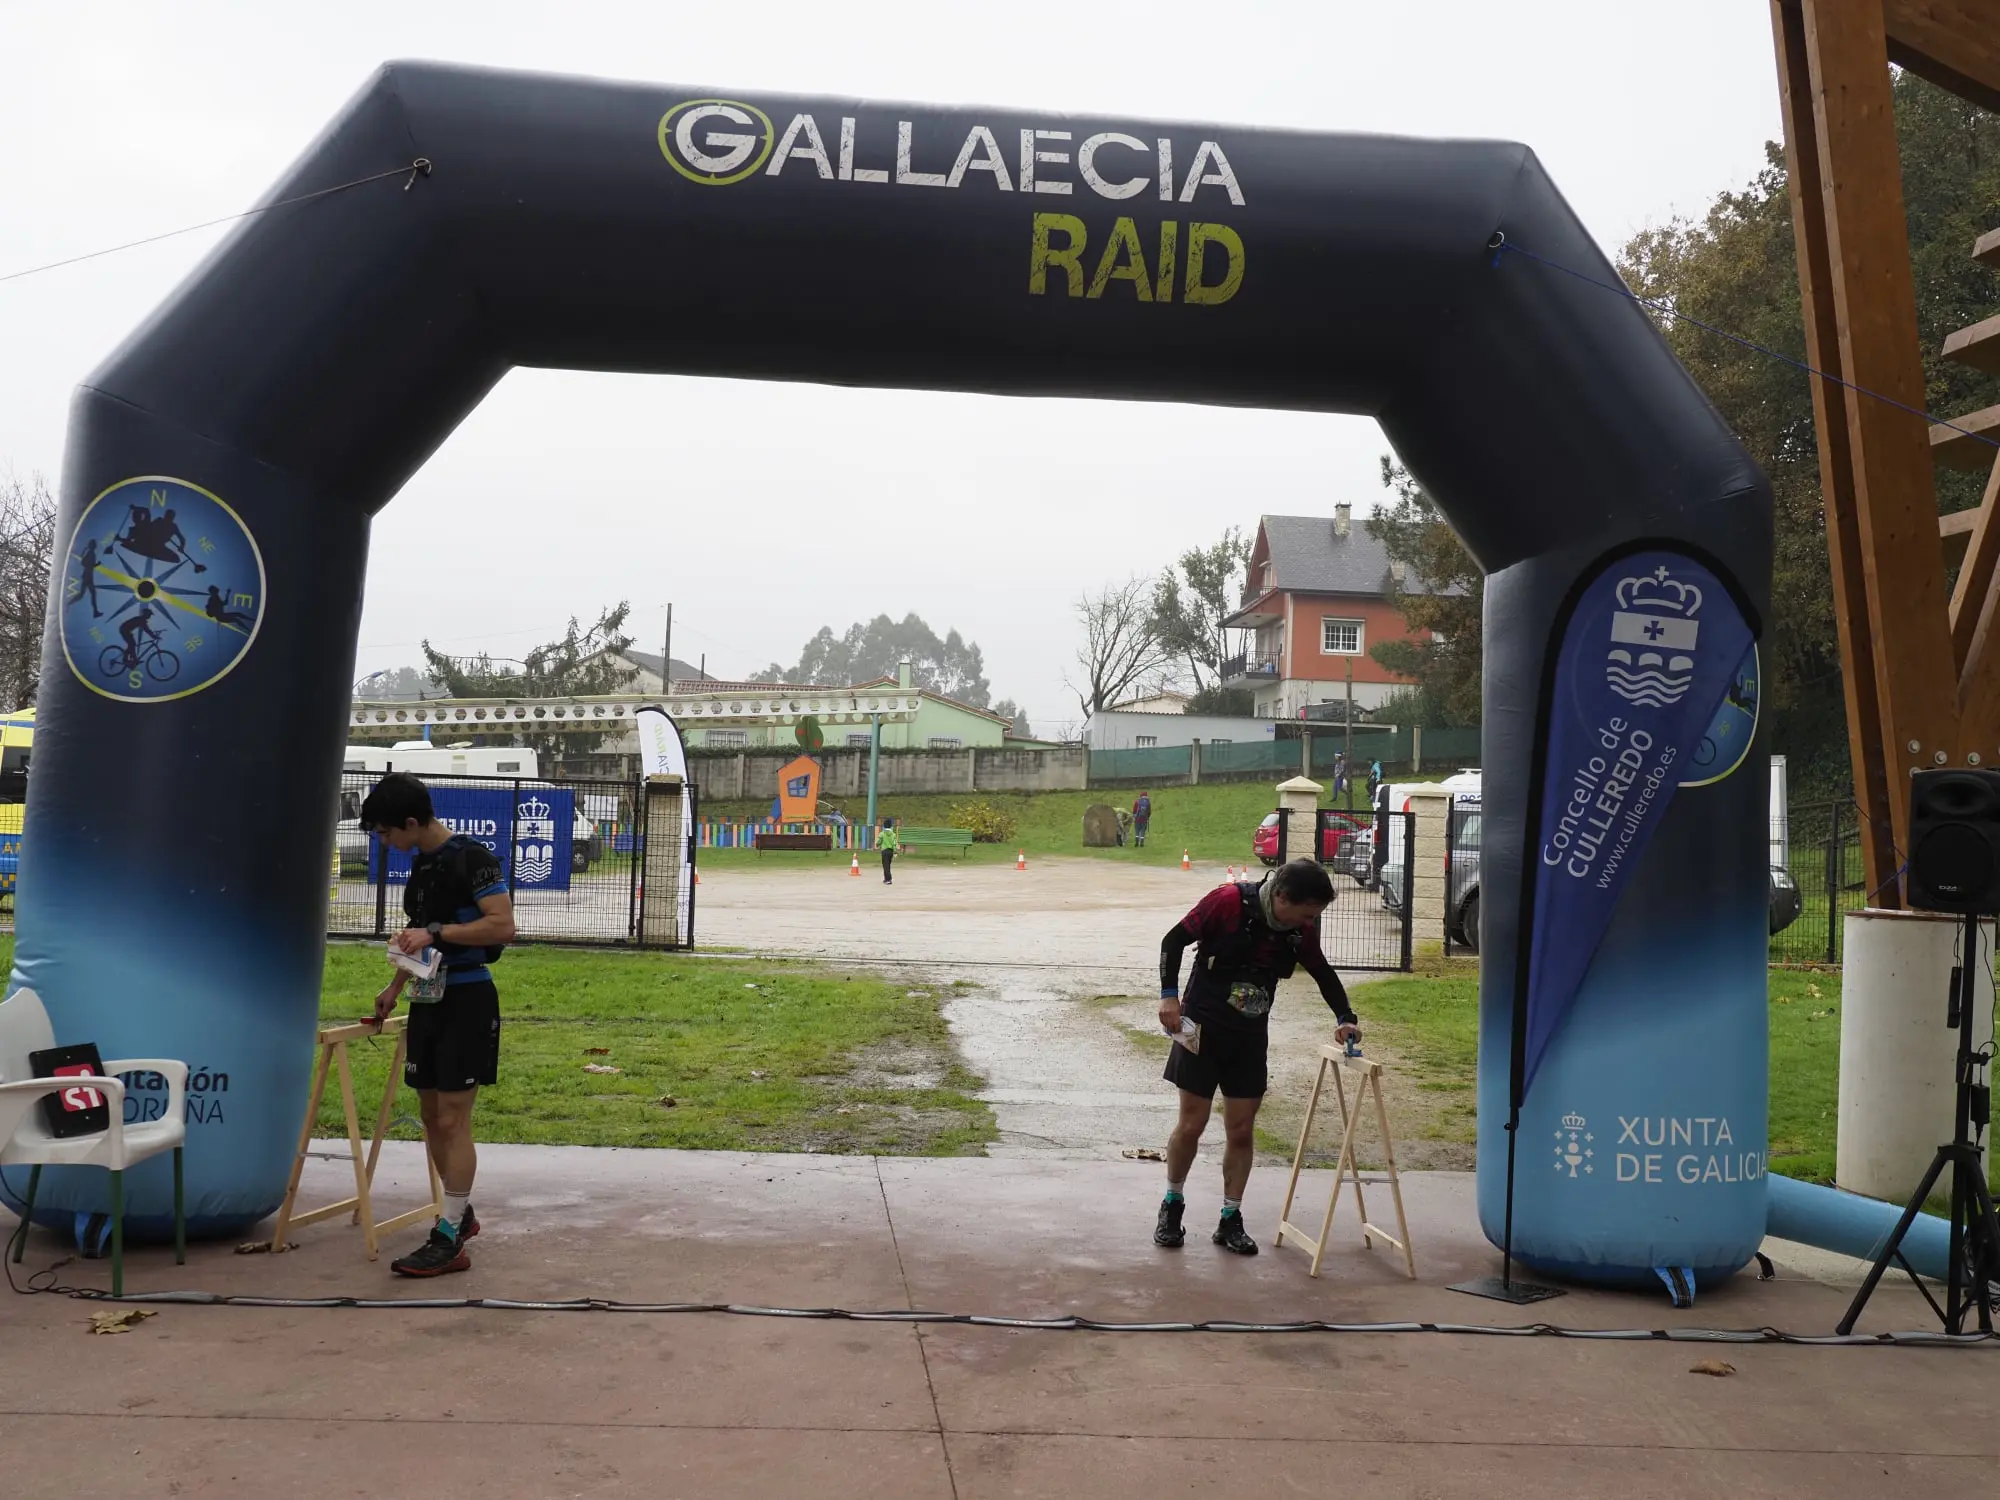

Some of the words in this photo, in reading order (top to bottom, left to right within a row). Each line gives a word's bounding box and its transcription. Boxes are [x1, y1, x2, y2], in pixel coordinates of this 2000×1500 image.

[675, 104, 1246, 206] GALLAECIA
[1028, 211, 1245, 305] RAID
[150, 489, 167, 508] N
[233, 593, 252, 608] E
[128, 670, 144, 689] S
[1543, 756, 1606, 866] Concello
[1598, 716, 1628, 750] de
[1567, 729, 1653, 878] CULLEREDO
[1596, 745, 1677, 889] www.culleredo.es
[1616, 1116, 1734, 1147] XUNTA
[1616, 1153, 1663, 1183] DE
[1676, 1149, 1768, 1184] GALICIA
